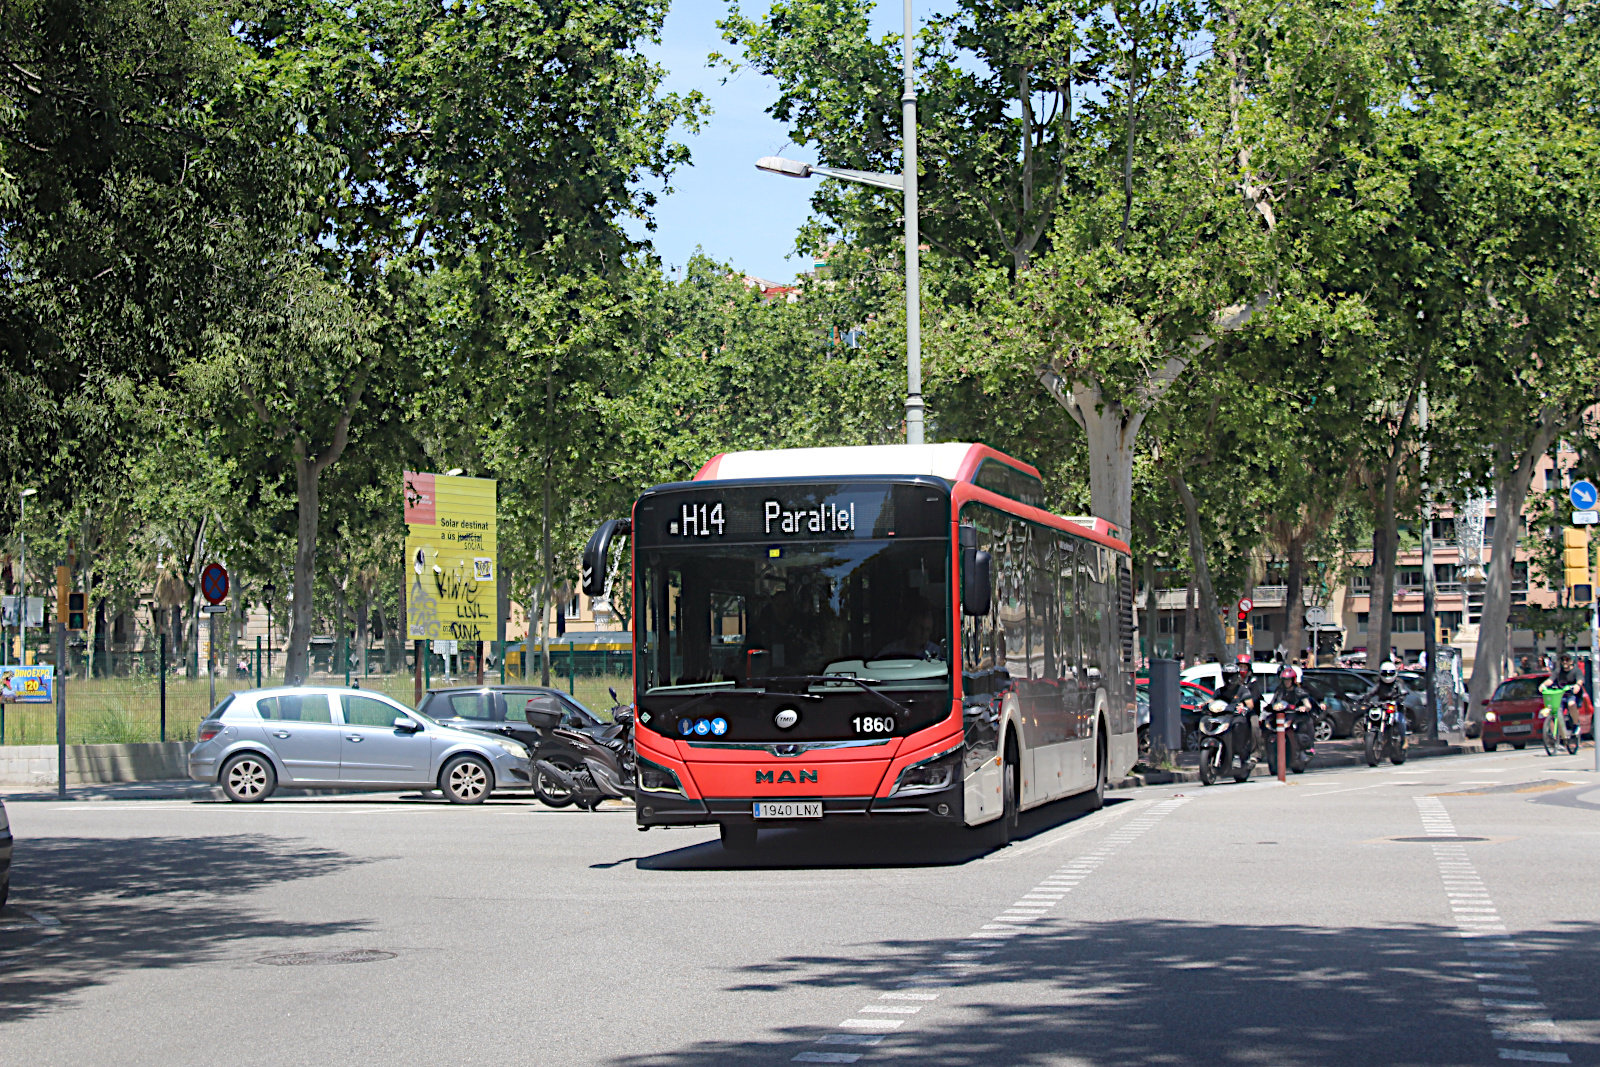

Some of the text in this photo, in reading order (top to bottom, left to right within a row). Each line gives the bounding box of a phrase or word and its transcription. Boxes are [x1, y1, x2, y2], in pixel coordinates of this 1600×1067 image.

[440, 517, 489, 531] Solar destinat
[682, 503, 725, 536] H14
[440, 532, 446, 540] a
[464, 542, 484, 551] SOCIAL
[24, 681, 39, 690] 120
[852, 716, 895, 733] 1860
[755, 769, 818, 784] MAN
[763, 804, 819, 816] 1940 LNX
